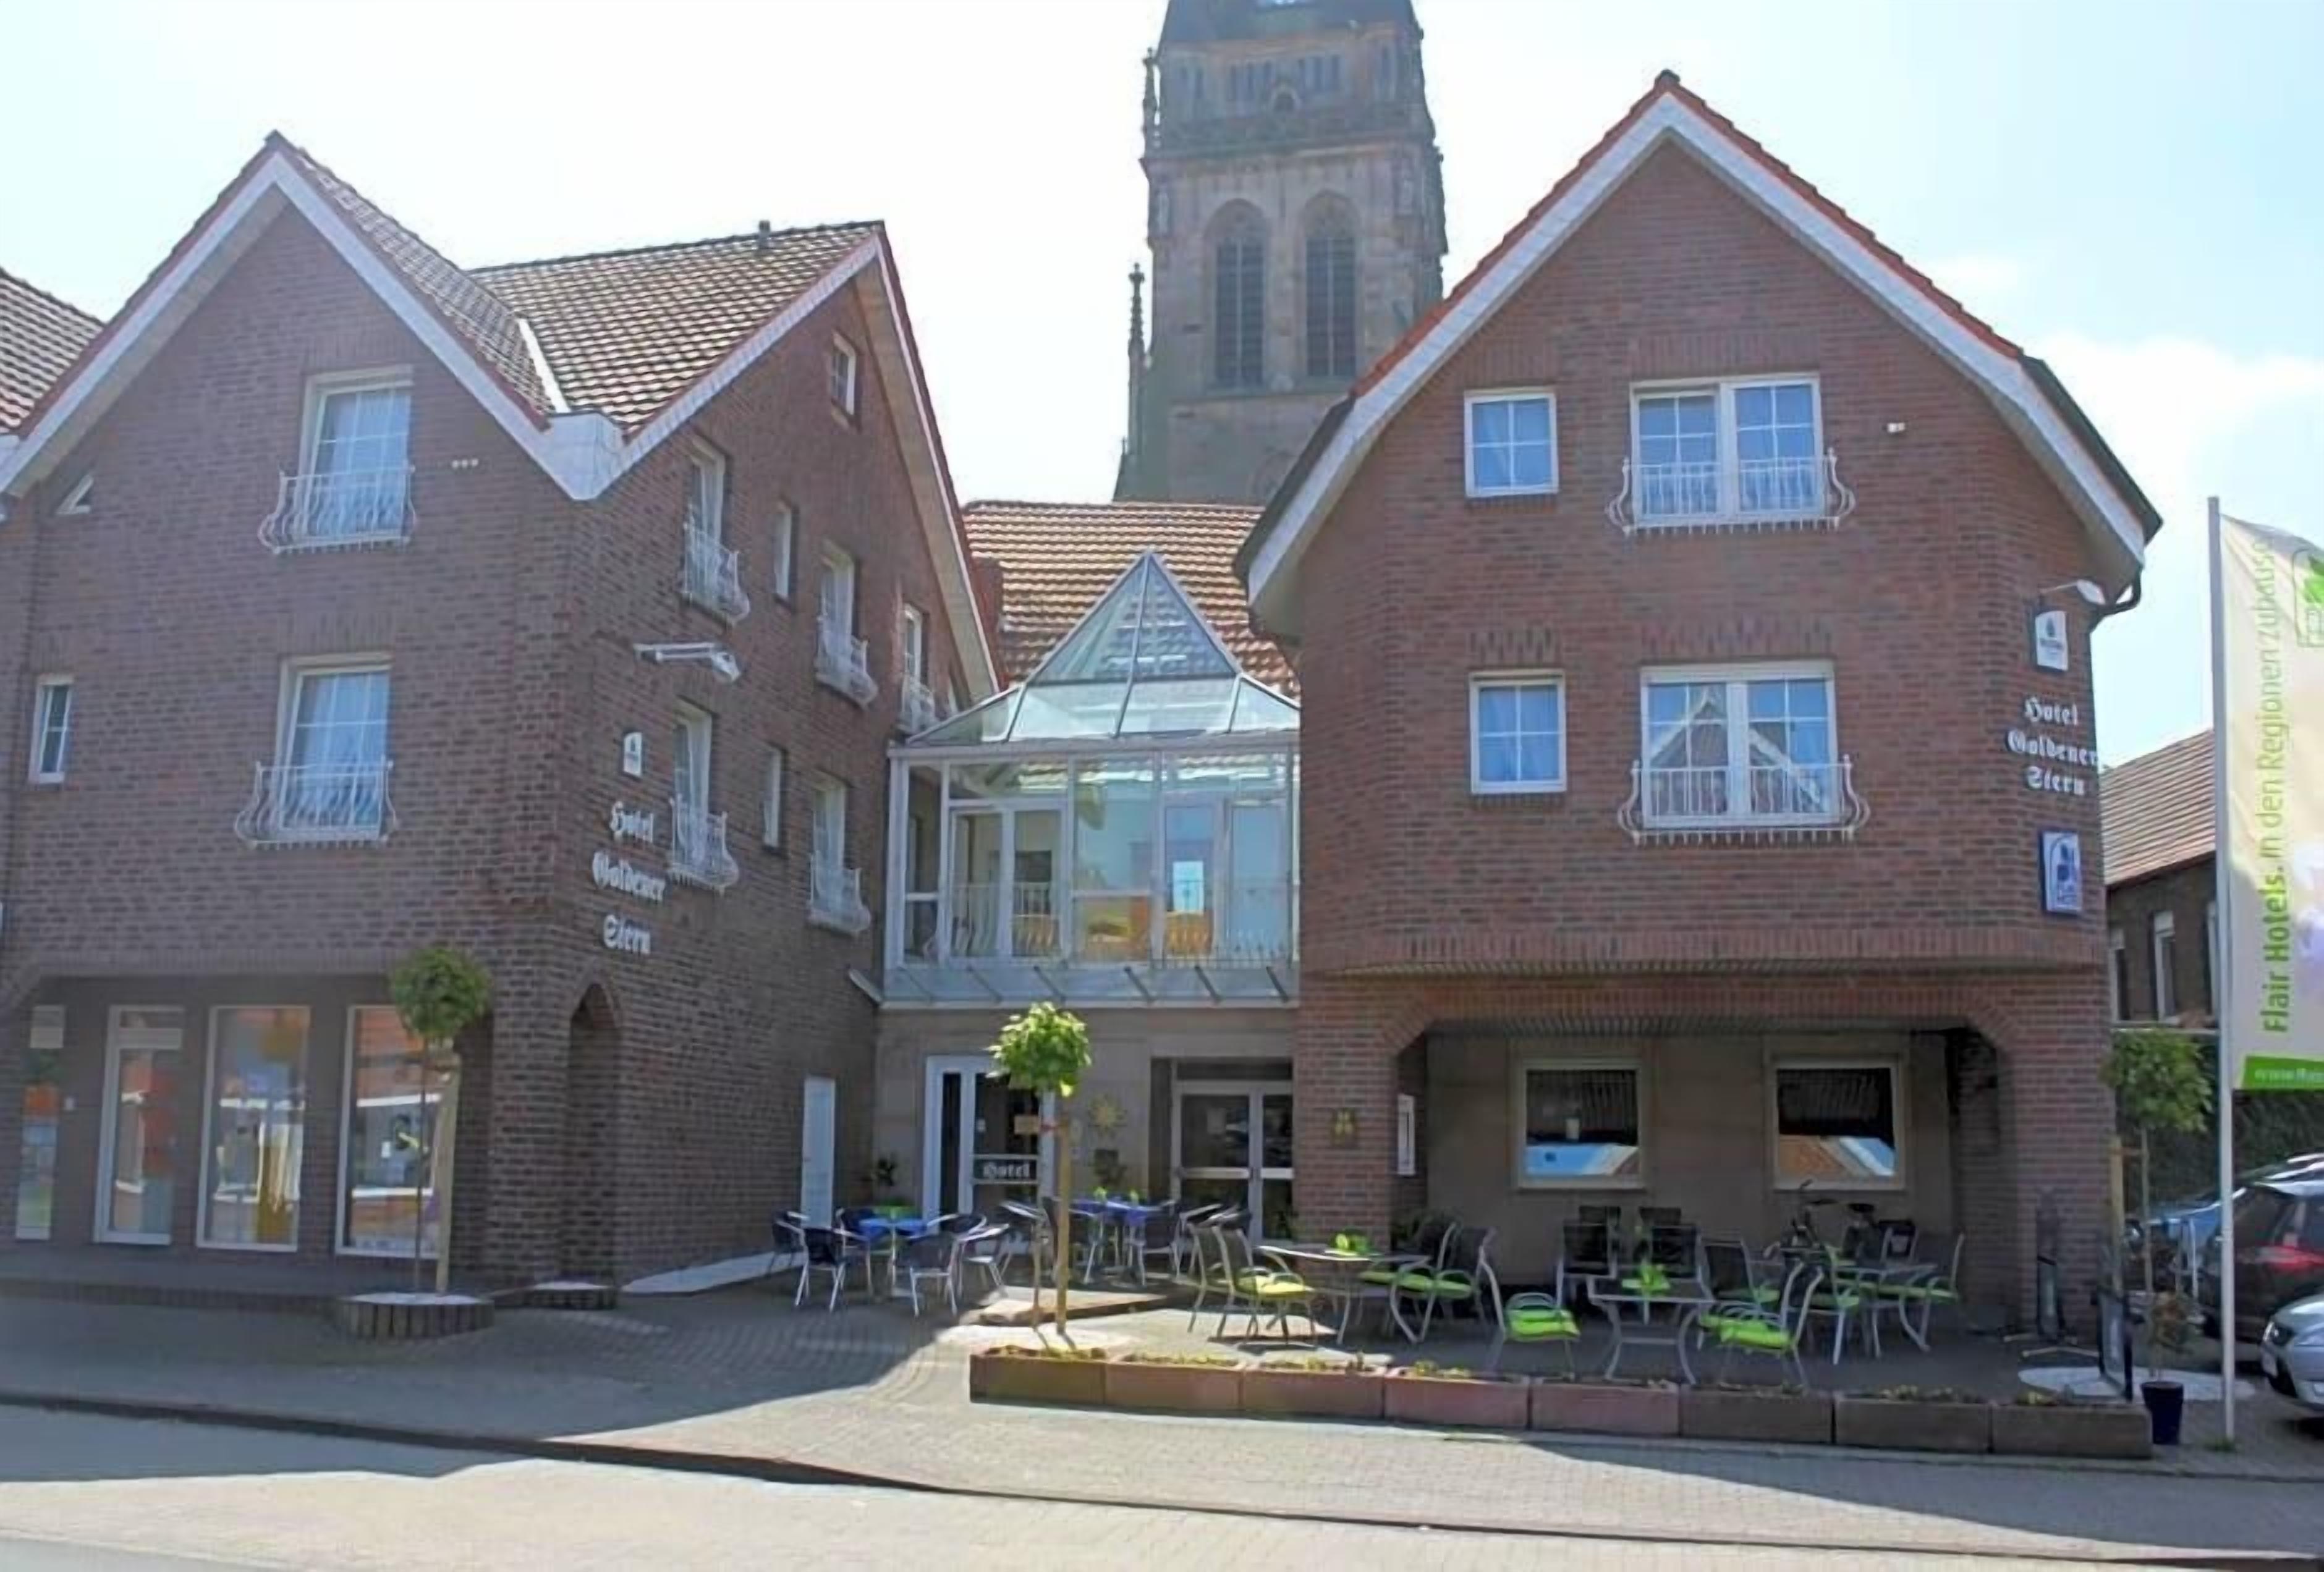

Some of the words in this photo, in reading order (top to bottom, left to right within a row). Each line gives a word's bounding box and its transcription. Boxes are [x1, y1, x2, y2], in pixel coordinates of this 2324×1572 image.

[2024, 696, 2078, 726] Hotel
[2255, 649, 2289, 770] Regionen
[2026, 765, 2085, 796] Stern
[2255, 779, 2285, 828] den
[2257, 864, 2291, 962] Hotels.
[2259, 971, 2291, 1033] Flair
[982, 1160, 1031, 1180] Hotel
